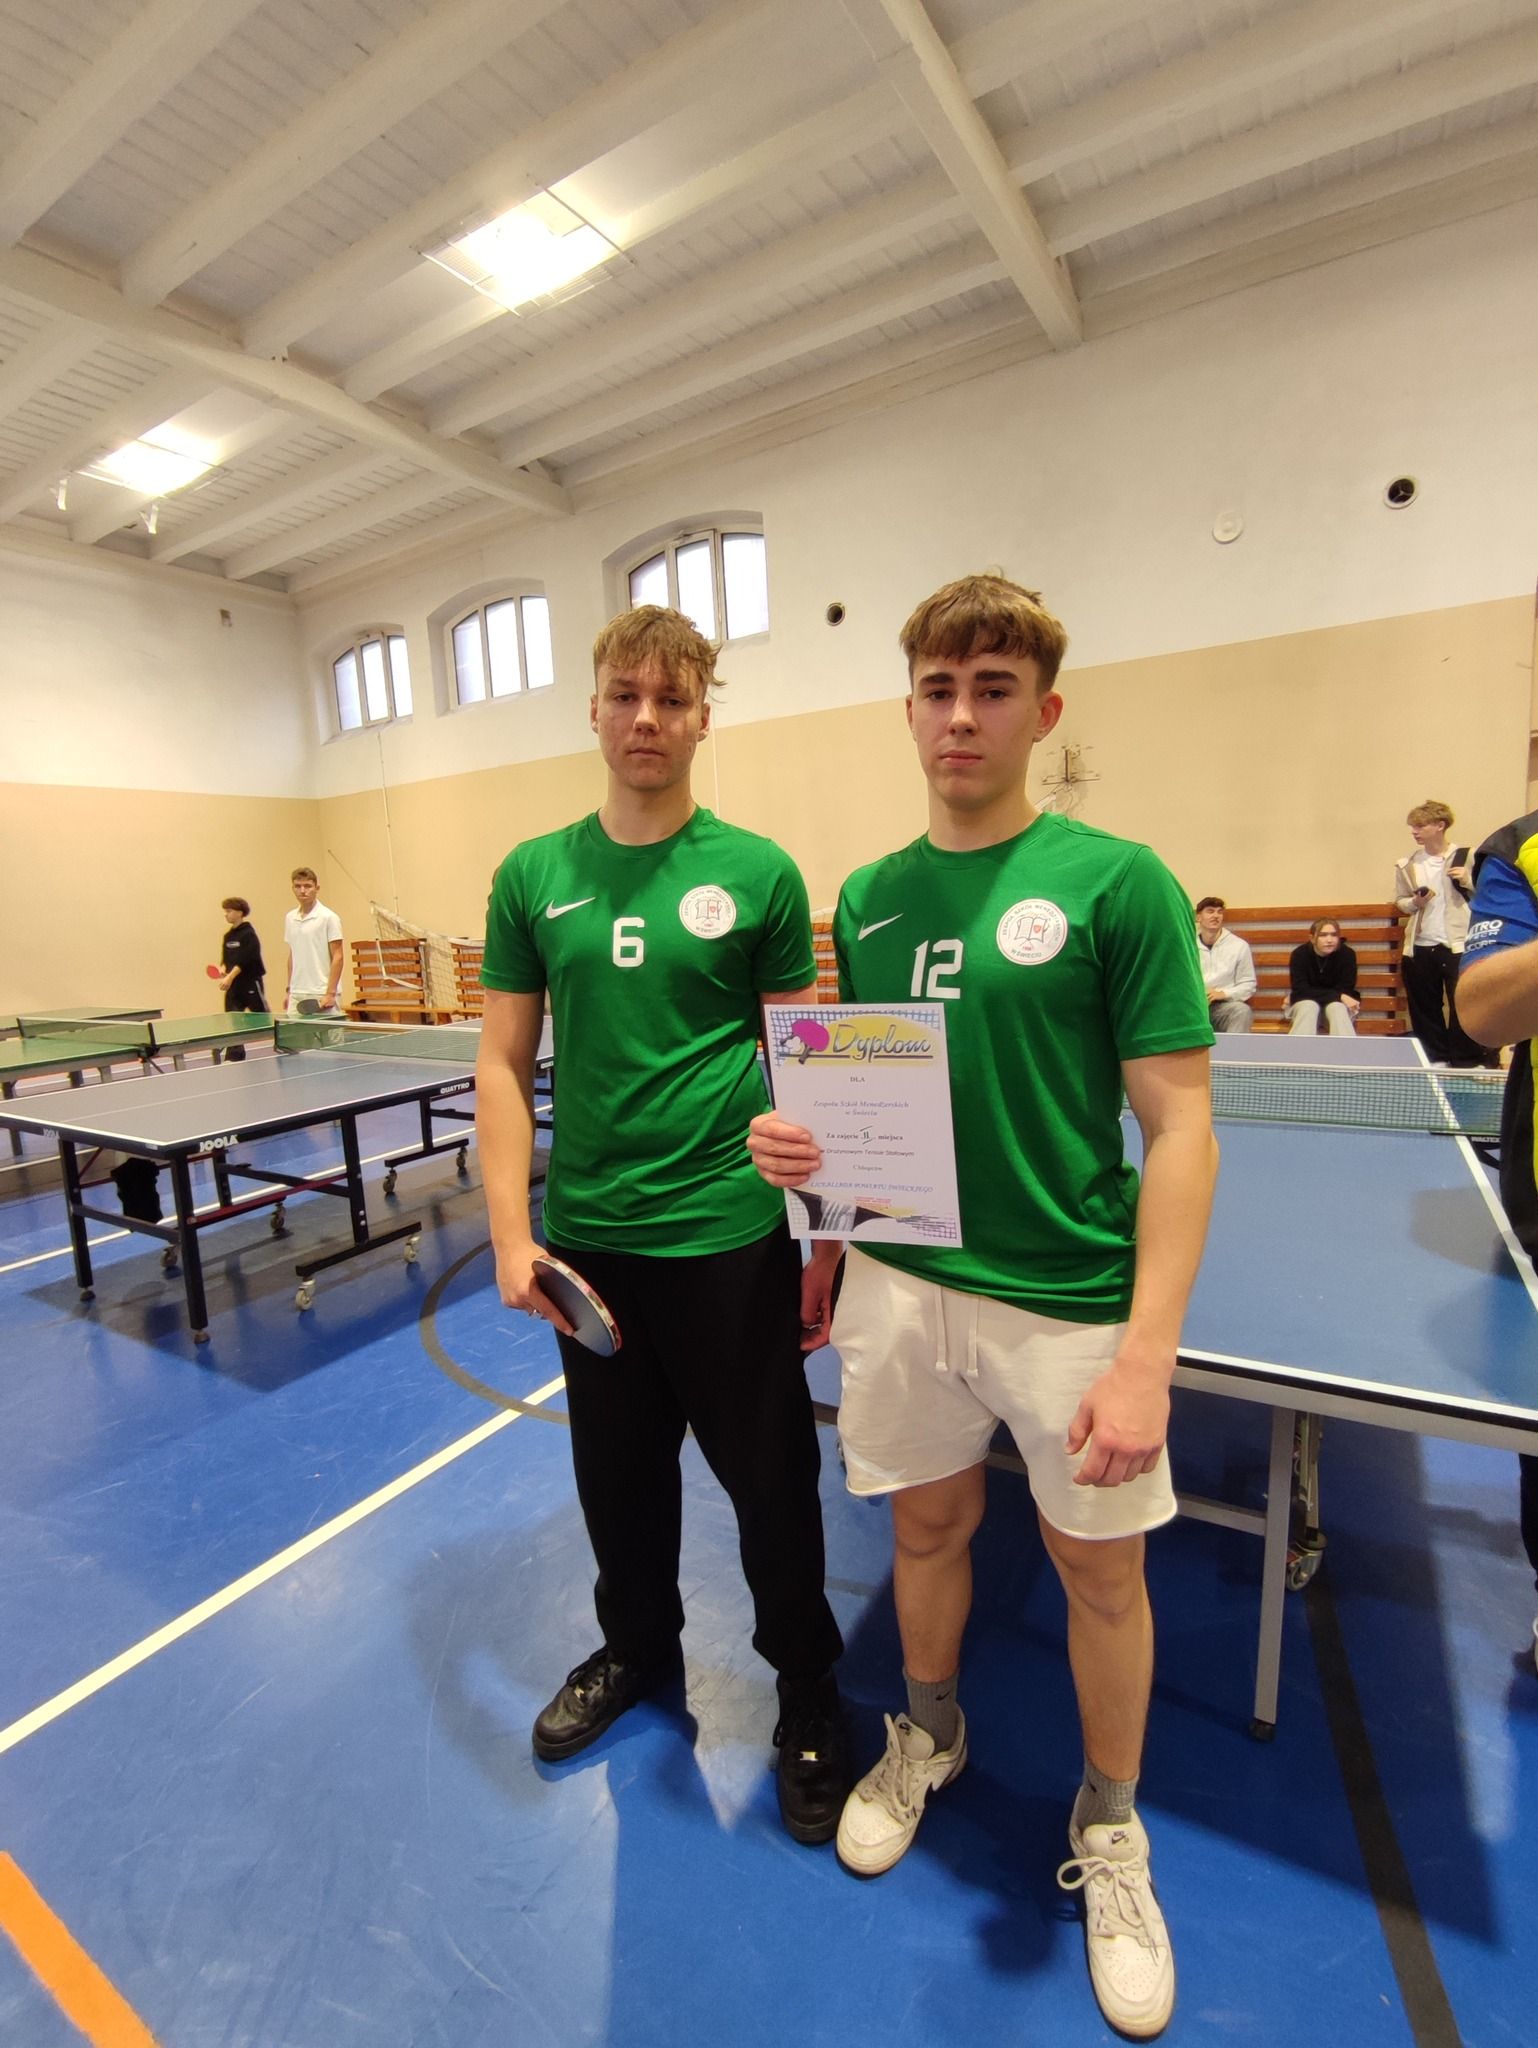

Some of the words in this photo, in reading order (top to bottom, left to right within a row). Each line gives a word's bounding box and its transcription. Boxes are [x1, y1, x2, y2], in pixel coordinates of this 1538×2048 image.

[612, 916, 645, 968] 6
[910, 938, 964, 1000] 12
[832, 1024, 931, 1063] Dyplom
[440, 1082, 470, 1094] QUATTRO
[199, 1134, 239, 1153] JOOLA
